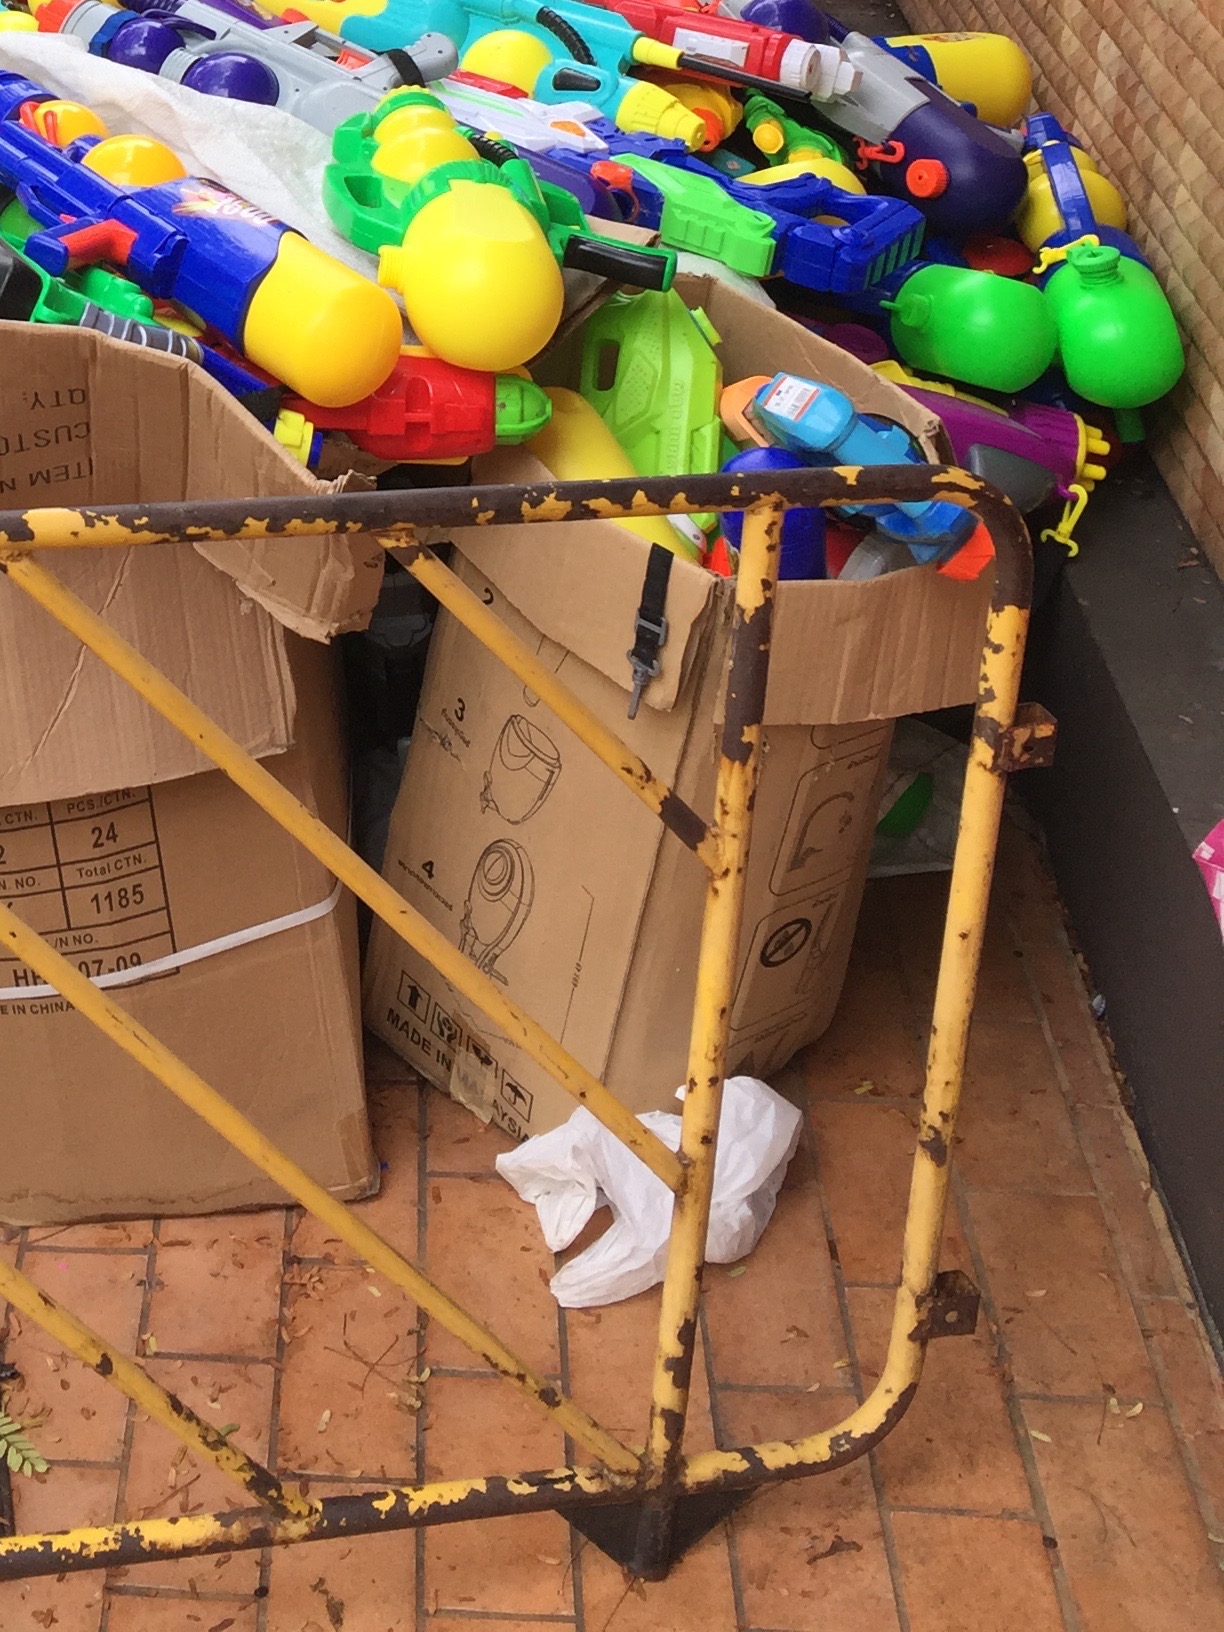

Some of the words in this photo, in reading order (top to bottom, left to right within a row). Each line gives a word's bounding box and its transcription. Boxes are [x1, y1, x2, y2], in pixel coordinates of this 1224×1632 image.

[28, 457, 94, 488] ITEM
[453, 697, 466, 722] 3
[5, 810, 38, 825] CTN.
[91, 821, 119, 849] 24
[15, 876, 42, 889] NO.
[76, 864, 112, 880] Total
[114, 853, 148, 871] CTN.
[421, 860, 435, 880] 4
[89, 883, 145, 915] 1185
[72, 933, 99, 945] NO.
[12, 1003, 27, 1015] IN
[30, 1000, 75, 1015] CHINA
[386, 1008, 431, 1057] MADE
[435, 1049, 454, 1074] IN
